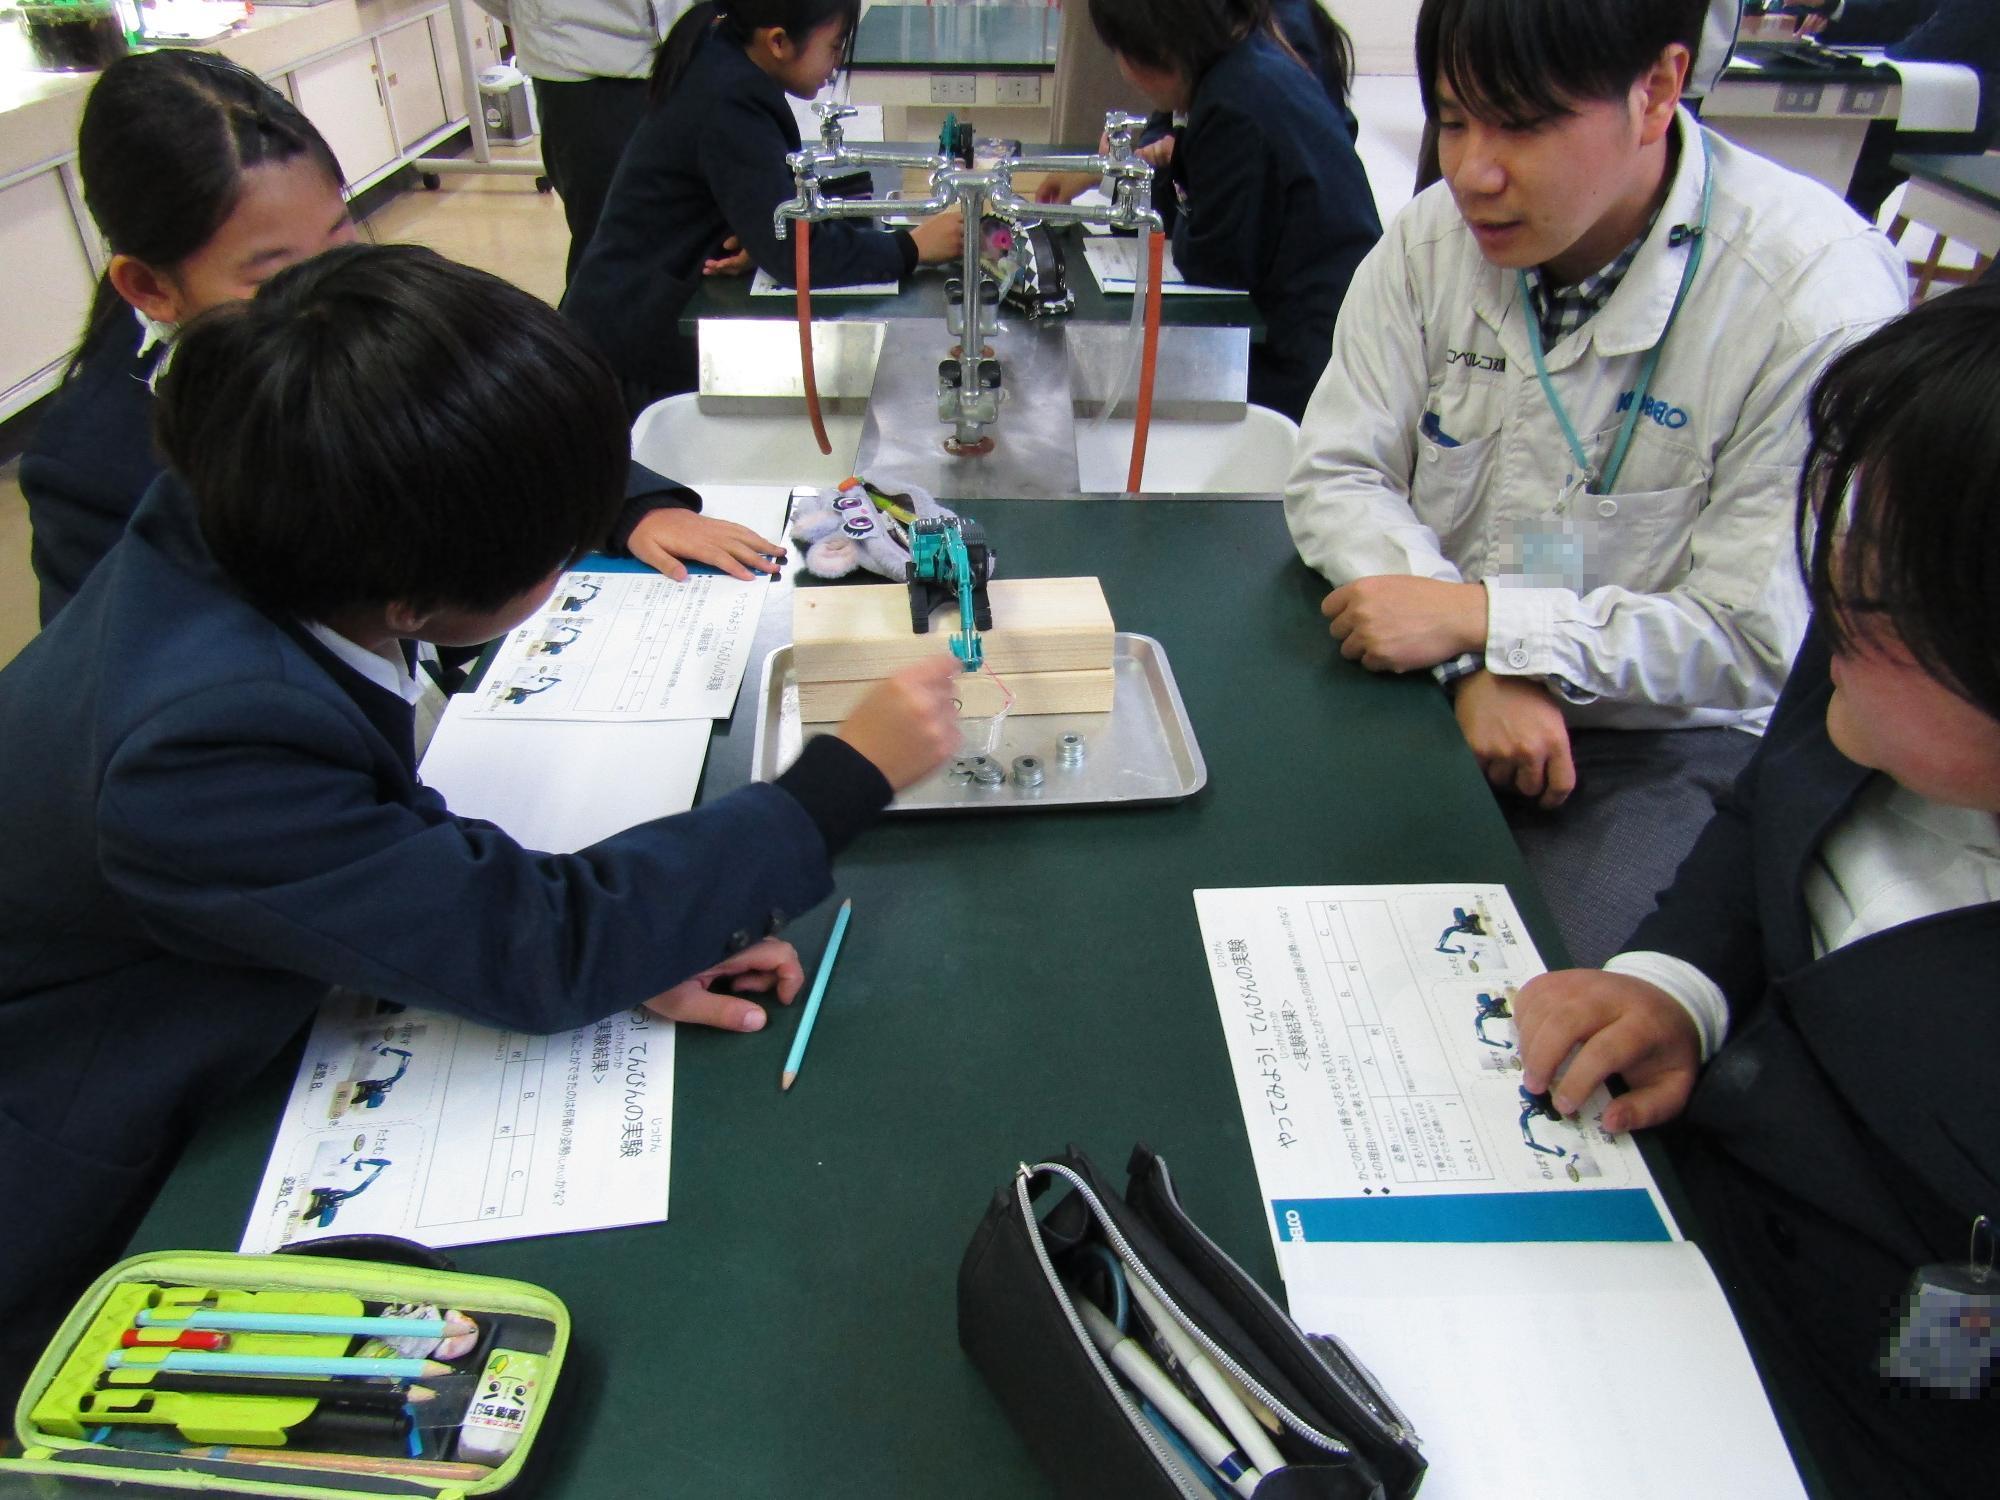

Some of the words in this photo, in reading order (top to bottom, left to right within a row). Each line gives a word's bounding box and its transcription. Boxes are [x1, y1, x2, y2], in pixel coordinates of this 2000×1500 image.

[1227, 938, 1268, 1036] てんびんの実験
[522, 1091, 535, 1102] B.
[621, 1042, 647, 1158] てんびんの実験
[511, 1170, 524, 1181] C.
